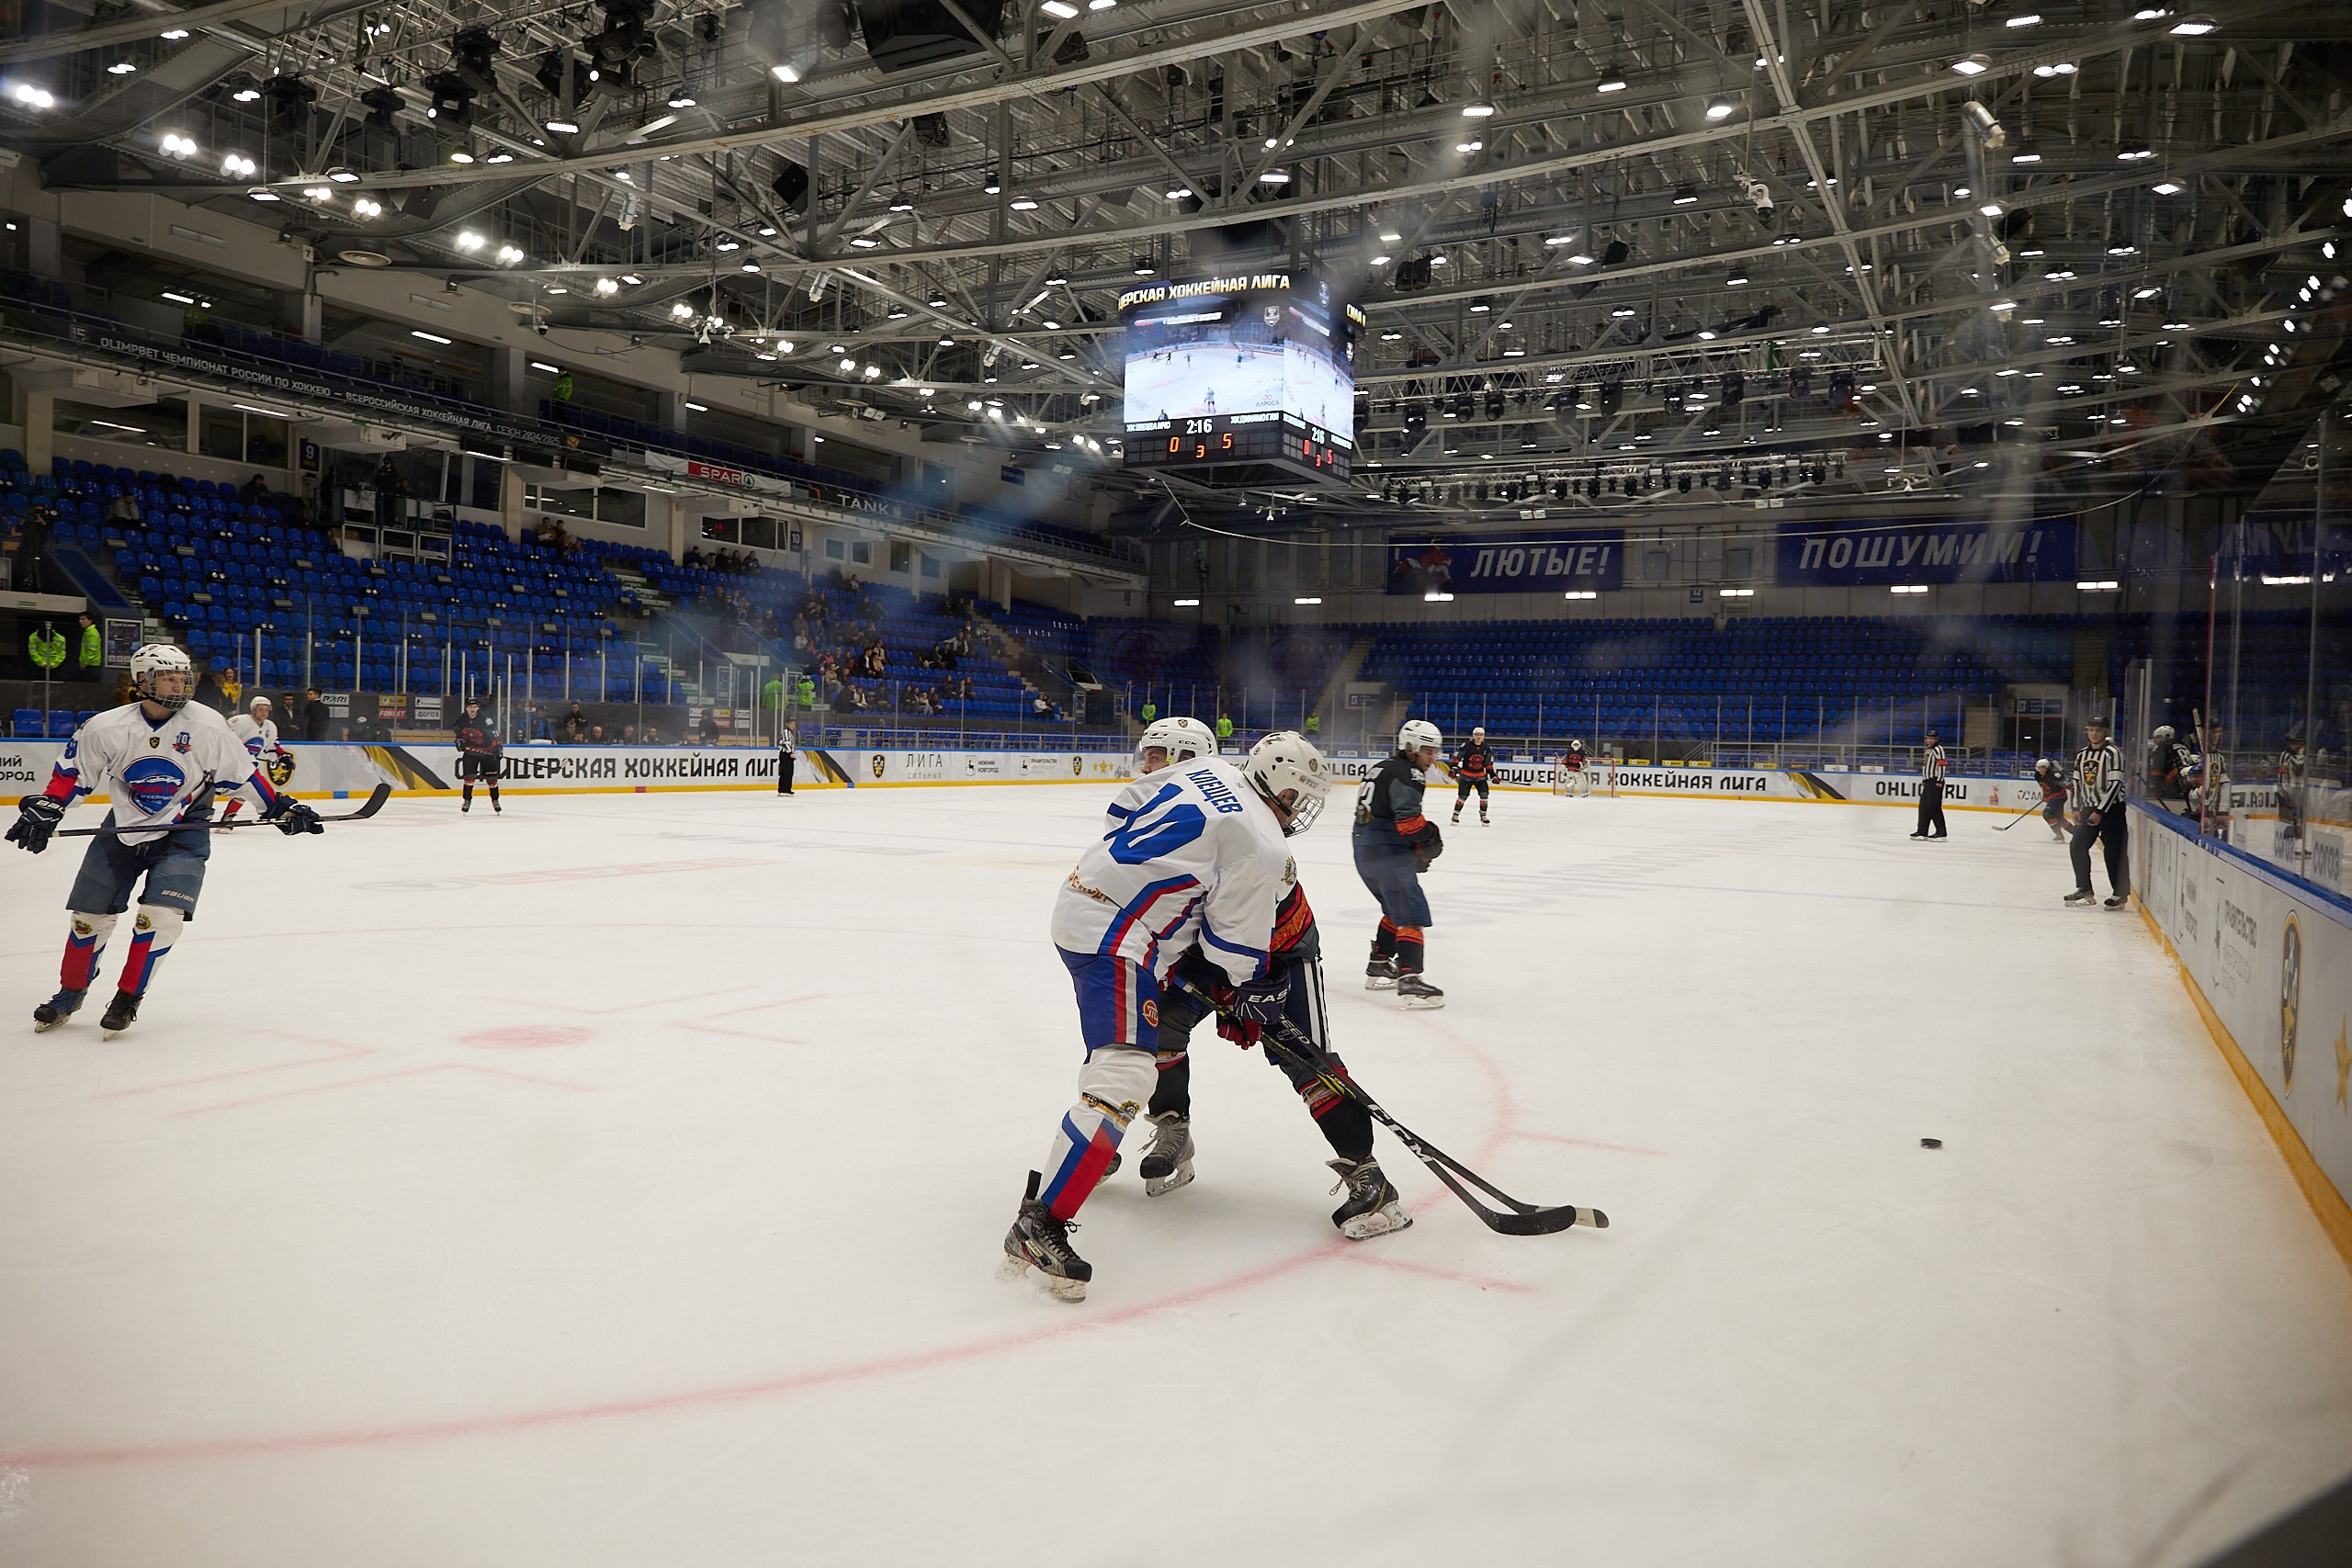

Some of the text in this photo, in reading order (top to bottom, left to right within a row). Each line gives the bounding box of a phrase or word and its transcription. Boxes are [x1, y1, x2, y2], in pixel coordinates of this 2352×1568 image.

[1169, 277, 1247, 299] ХОККЕЙНАЯ
[1251, 275, 1290, 290] ЛИГА
[100, 337, 159, 358] OLIMPBET
[163, 351, 228, 374] ЧЕМПИОНАТ
[232, 367, 272, 384] РОССИИ
[275, 377, 288, 387] ПО
[291, 380, 331, 397] ХОККЕЮ
[345, 392, 420, 415] ВСЕРОССИЙСКАЯ
[421, 408, 469, 426] ХОККЕЙНАЯ
[470, 419, 492, 432] ЛИГА
[496, 424, 521, 436] СЕЗОН
[522, 430, 560, 446] 2024/2025
[1186, 419, 1213, 434] 2:16
[306, 445, 314, 459] 9
[1170, 433, 1232, 453] 0 5
[1196, 445, 1205, 458] 3
[700, 467, 741, 484] SPAR
[837, 493, 888, 514] TANK
[791, 533, 800, 544] 10
[1799, 531, 2042, 570] ПОШУМИМ!
[1470, 547, 1610, 578] ЛЮТЫЕ!
[0, 755, 22, 767] ИЙ
[455, 752, 782, 782] ОИЦЕРСКАЯ ХОККЕЙНАЯ ЛИГ
[906, 754, 943, 768] ЛИГА
[908, 772, 942, 780] СИЛЬНЫХ
[1608, 770, 1713, 790] ХОККЕЙНАЯ
[1720, 776, 1766, 791] ЛИГА
[1185, 769, 1244, 815] КЛЕЩЕВ
[1875, 781, 1967, 800] OHLIRU
[1103, 783, 1206, 864] 10
[1367, 1104, 1433, 1163] CCM
